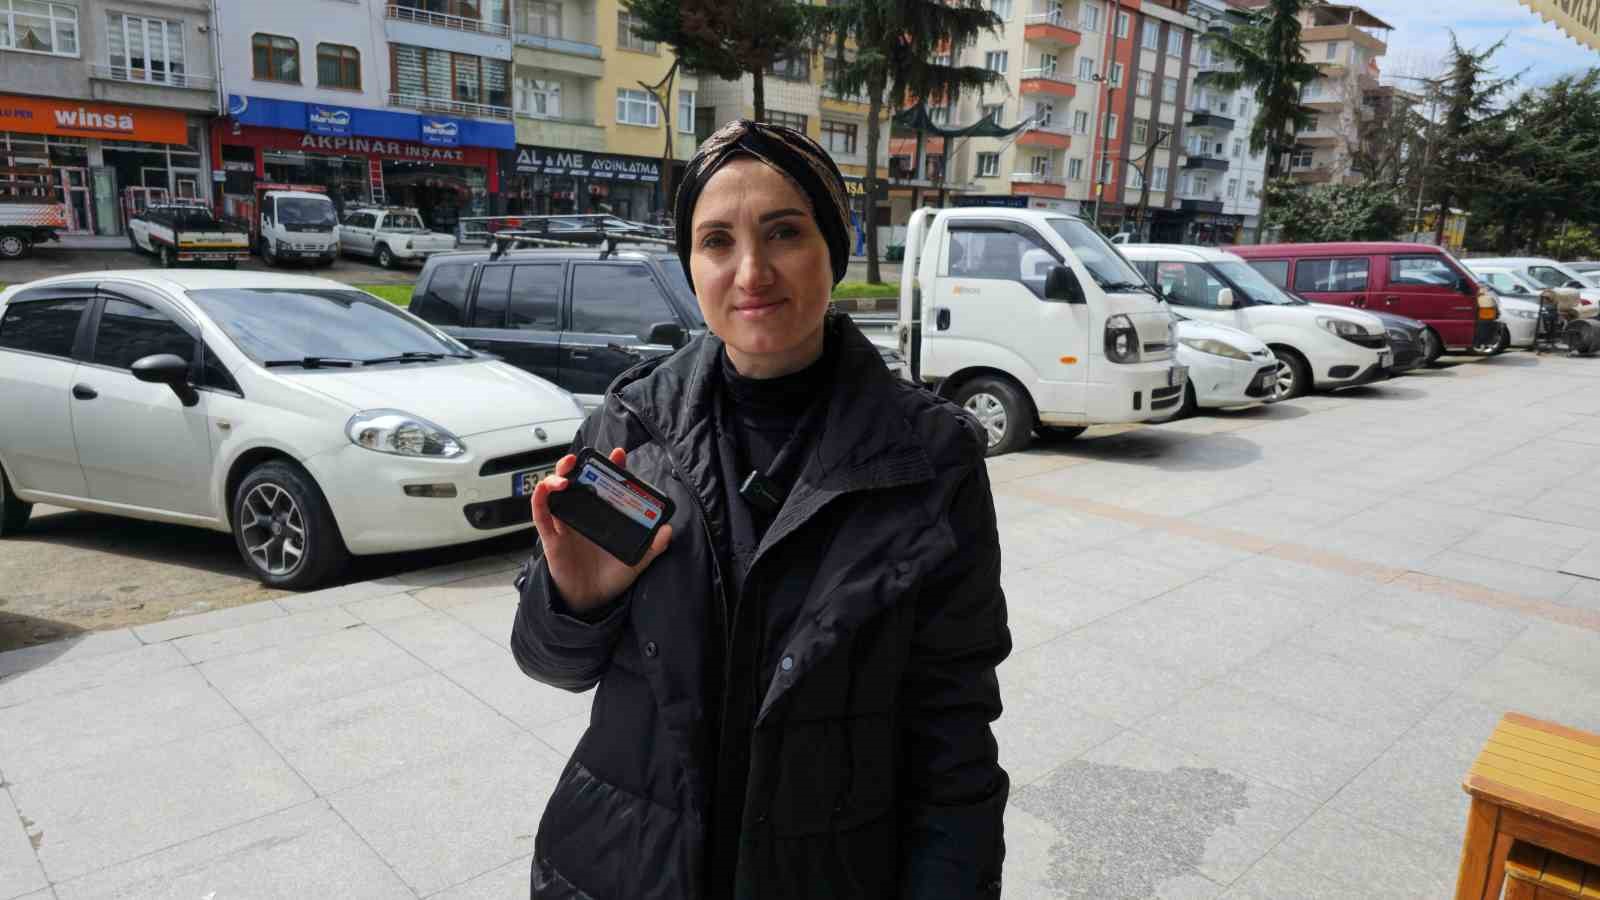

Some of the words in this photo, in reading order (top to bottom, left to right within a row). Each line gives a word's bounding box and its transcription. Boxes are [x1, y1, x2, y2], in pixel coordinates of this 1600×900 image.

[54, 108, 134, 129] winsa
[301, 134, 400, 154] AKPINAR
[516, 149, 543, 165] AL
[556, 152, 584, 168] ME
